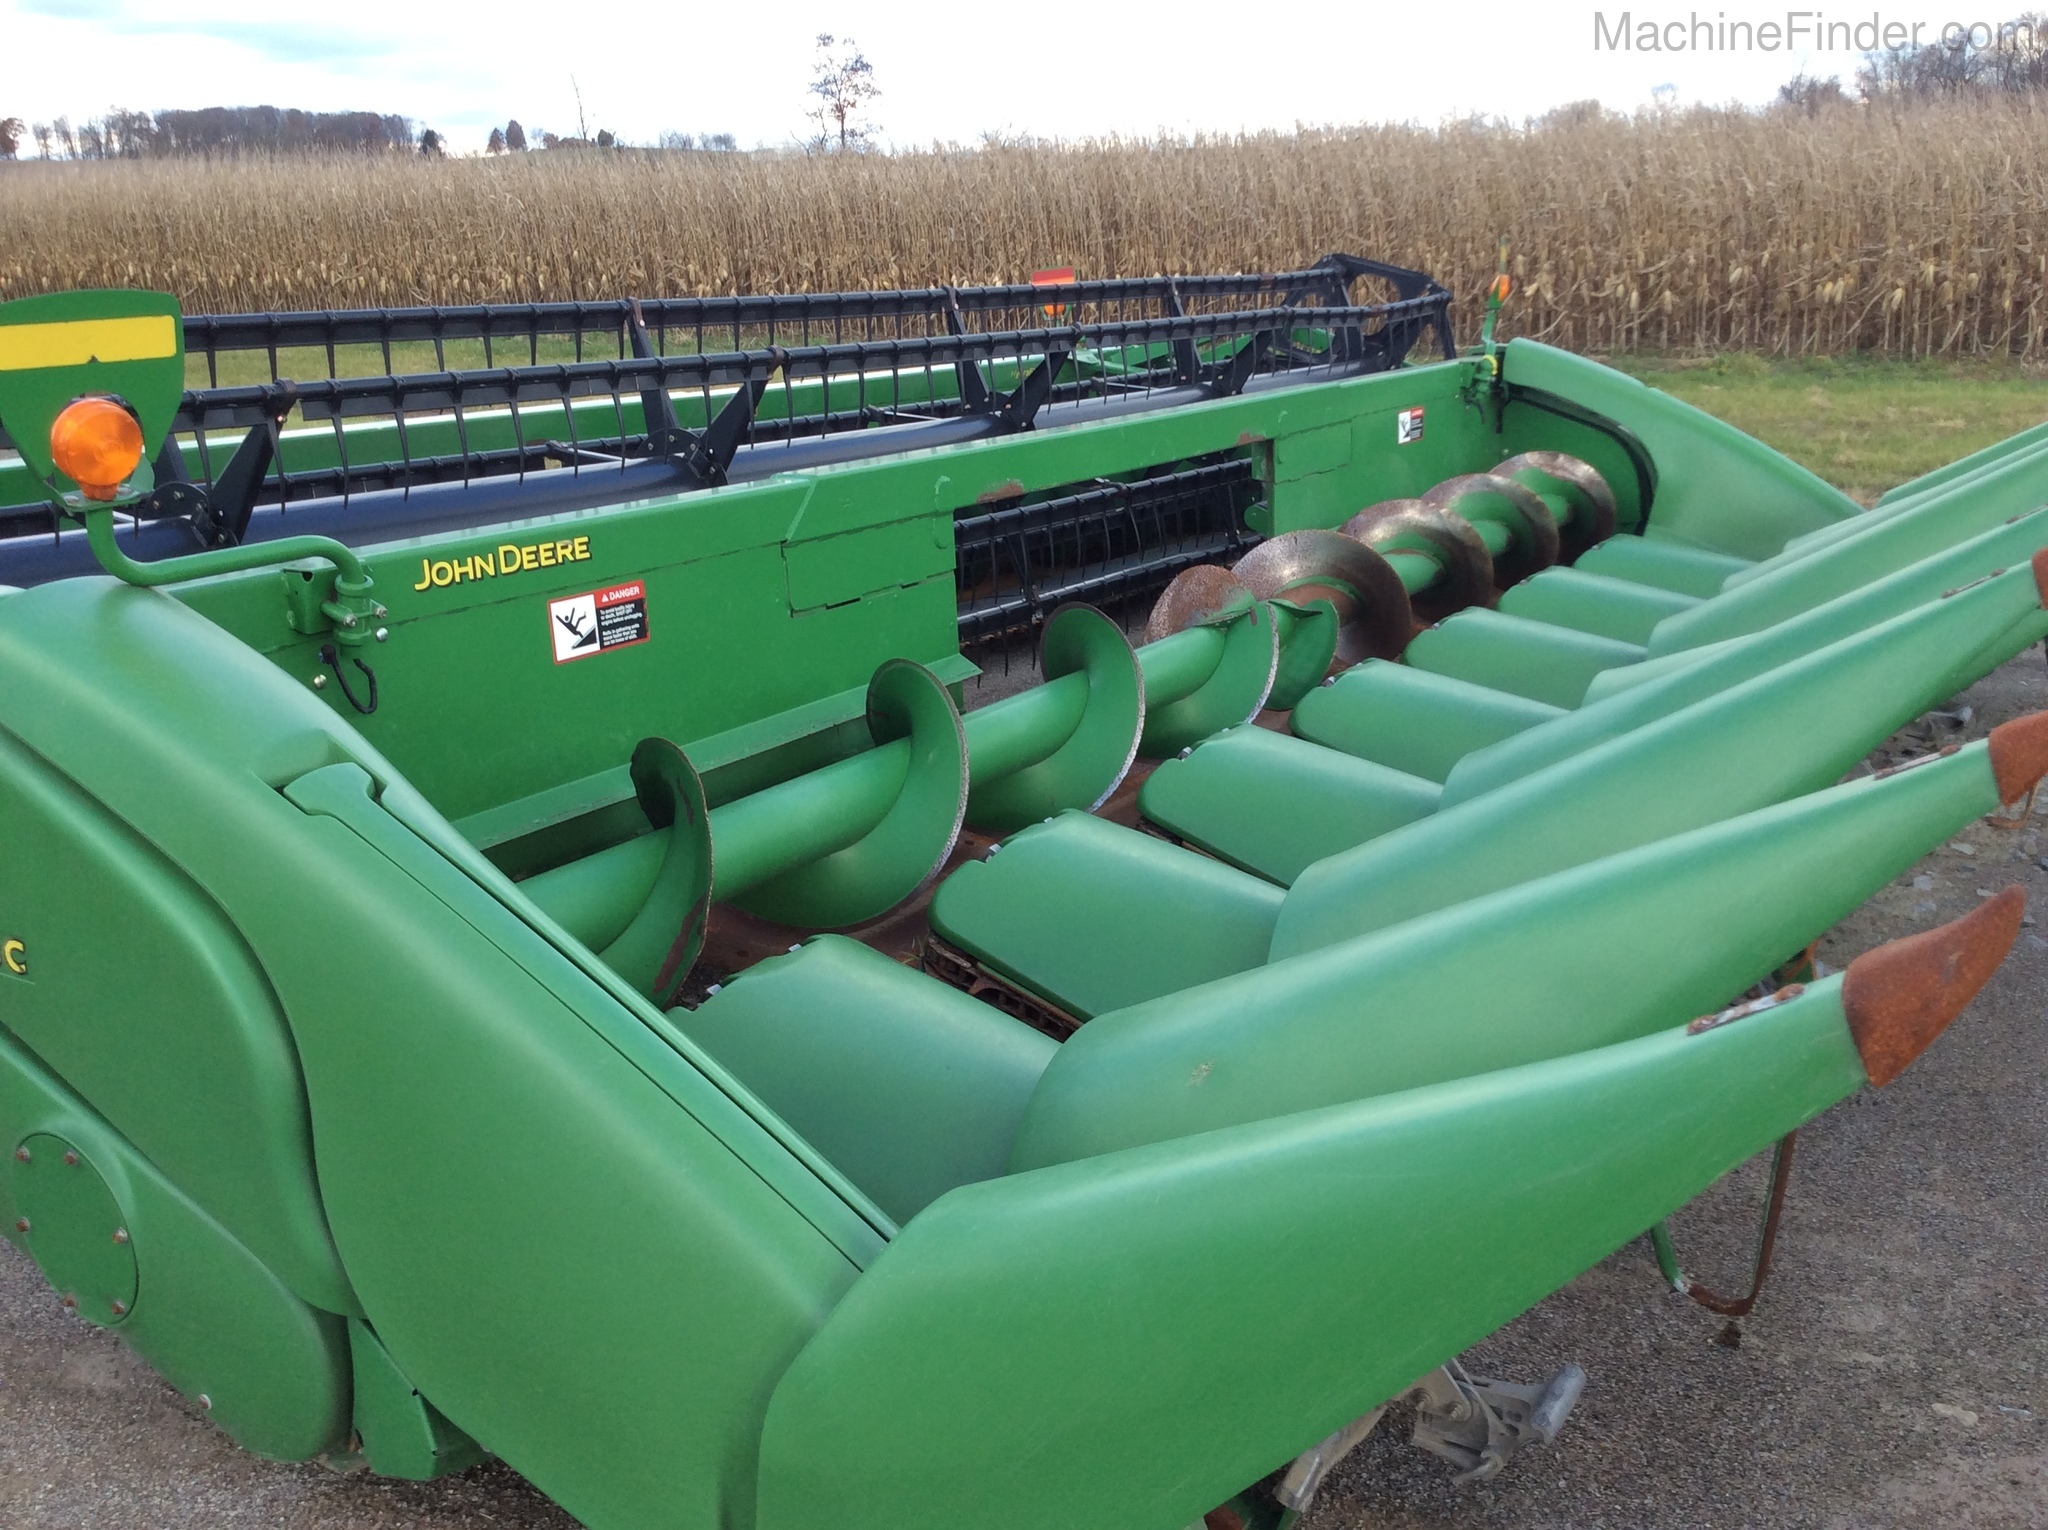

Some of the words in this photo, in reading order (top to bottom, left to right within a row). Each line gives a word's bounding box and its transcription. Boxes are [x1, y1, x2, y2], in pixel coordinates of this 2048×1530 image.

[413, 552, 497, 592] JOHN
[497, 536, 592, 576] DEERE
[609, 585, 640, 601] DANGER
